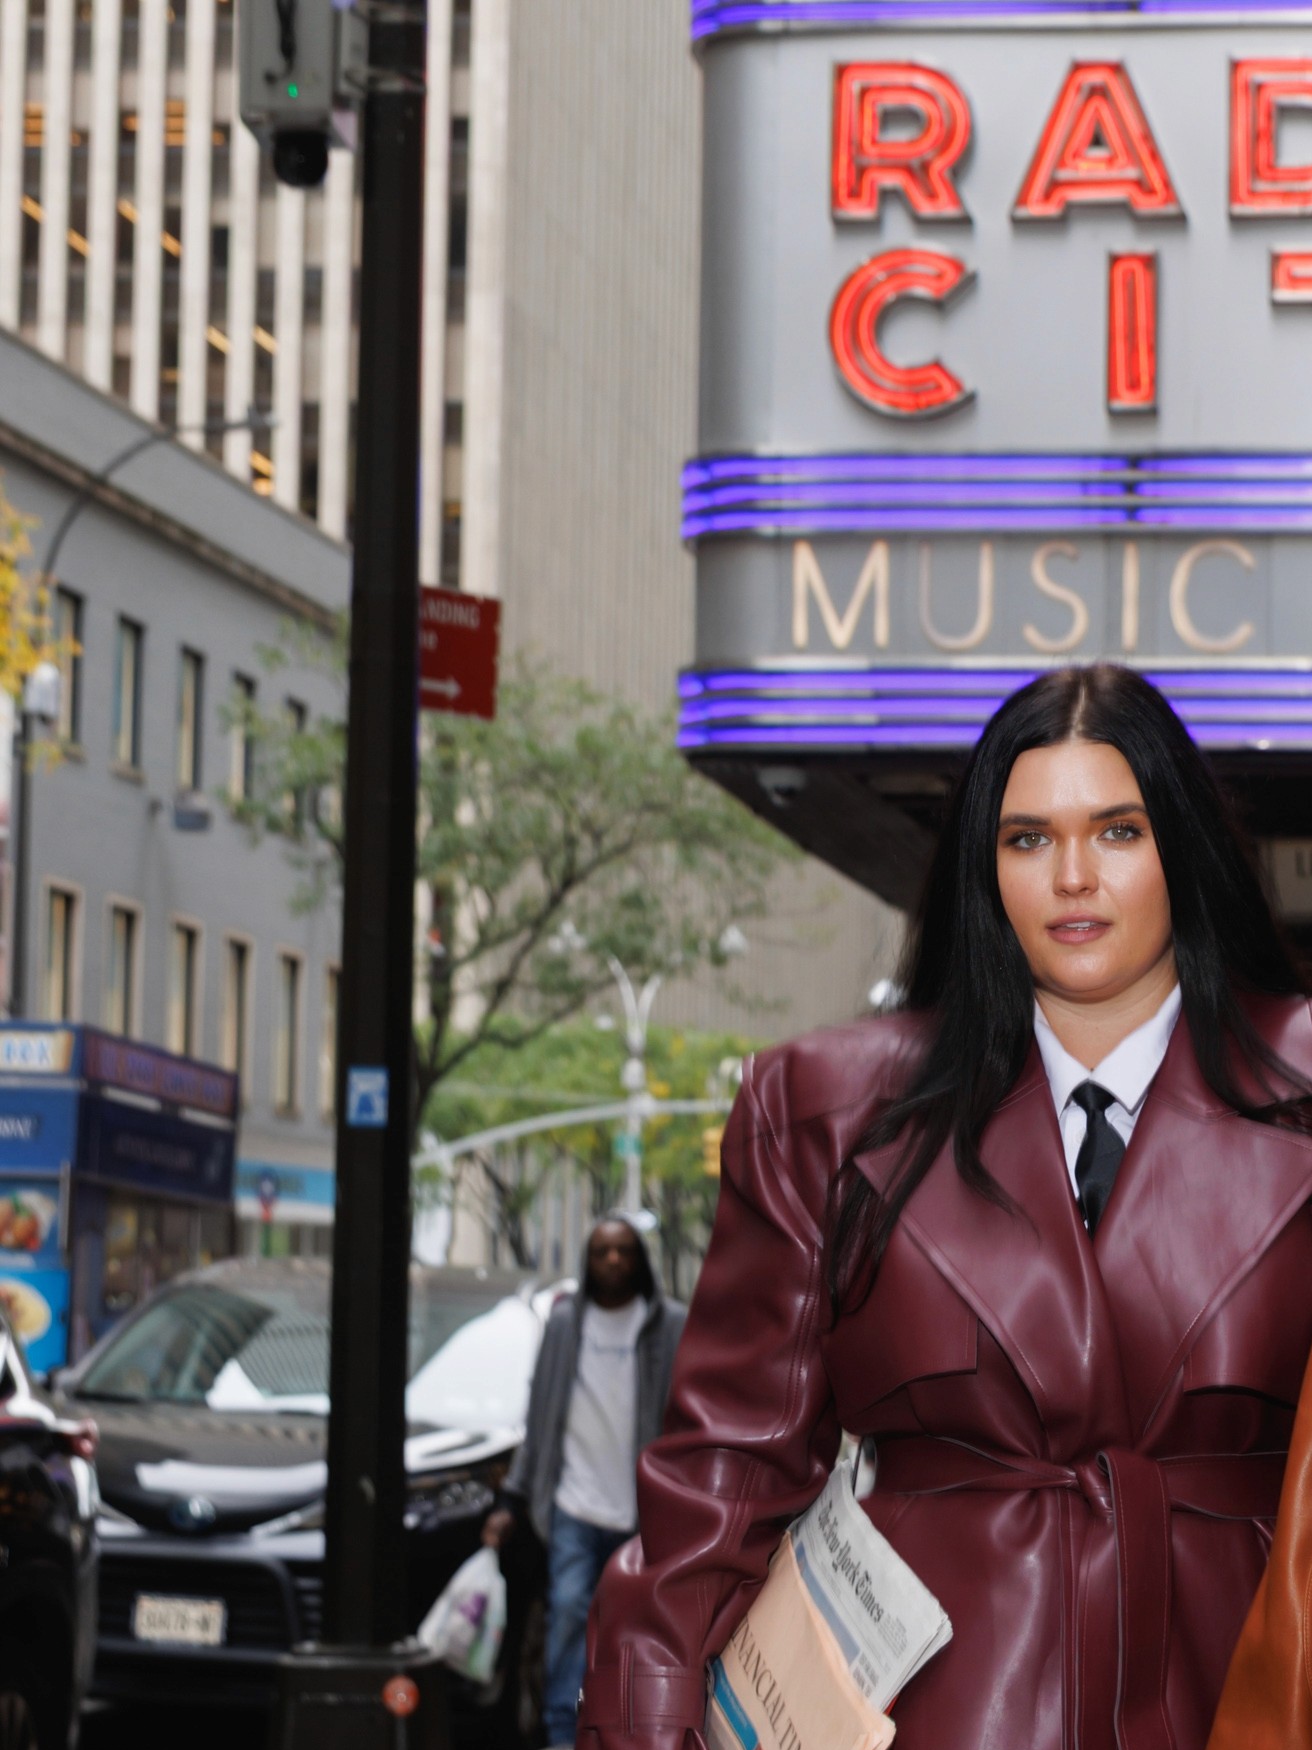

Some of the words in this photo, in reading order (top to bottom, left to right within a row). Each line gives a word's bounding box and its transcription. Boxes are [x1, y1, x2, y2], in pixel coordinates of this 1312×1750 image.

[790, 540, 1258, 654] MUSIC
[818, 1500, 833, 1533] The
[824, 1516, 842, 1554] New
[832, 1541, 861, 1588] York
[854, 1569, 884, 1624] Times
[728, 1616, 785, 1736] INANCIAL
